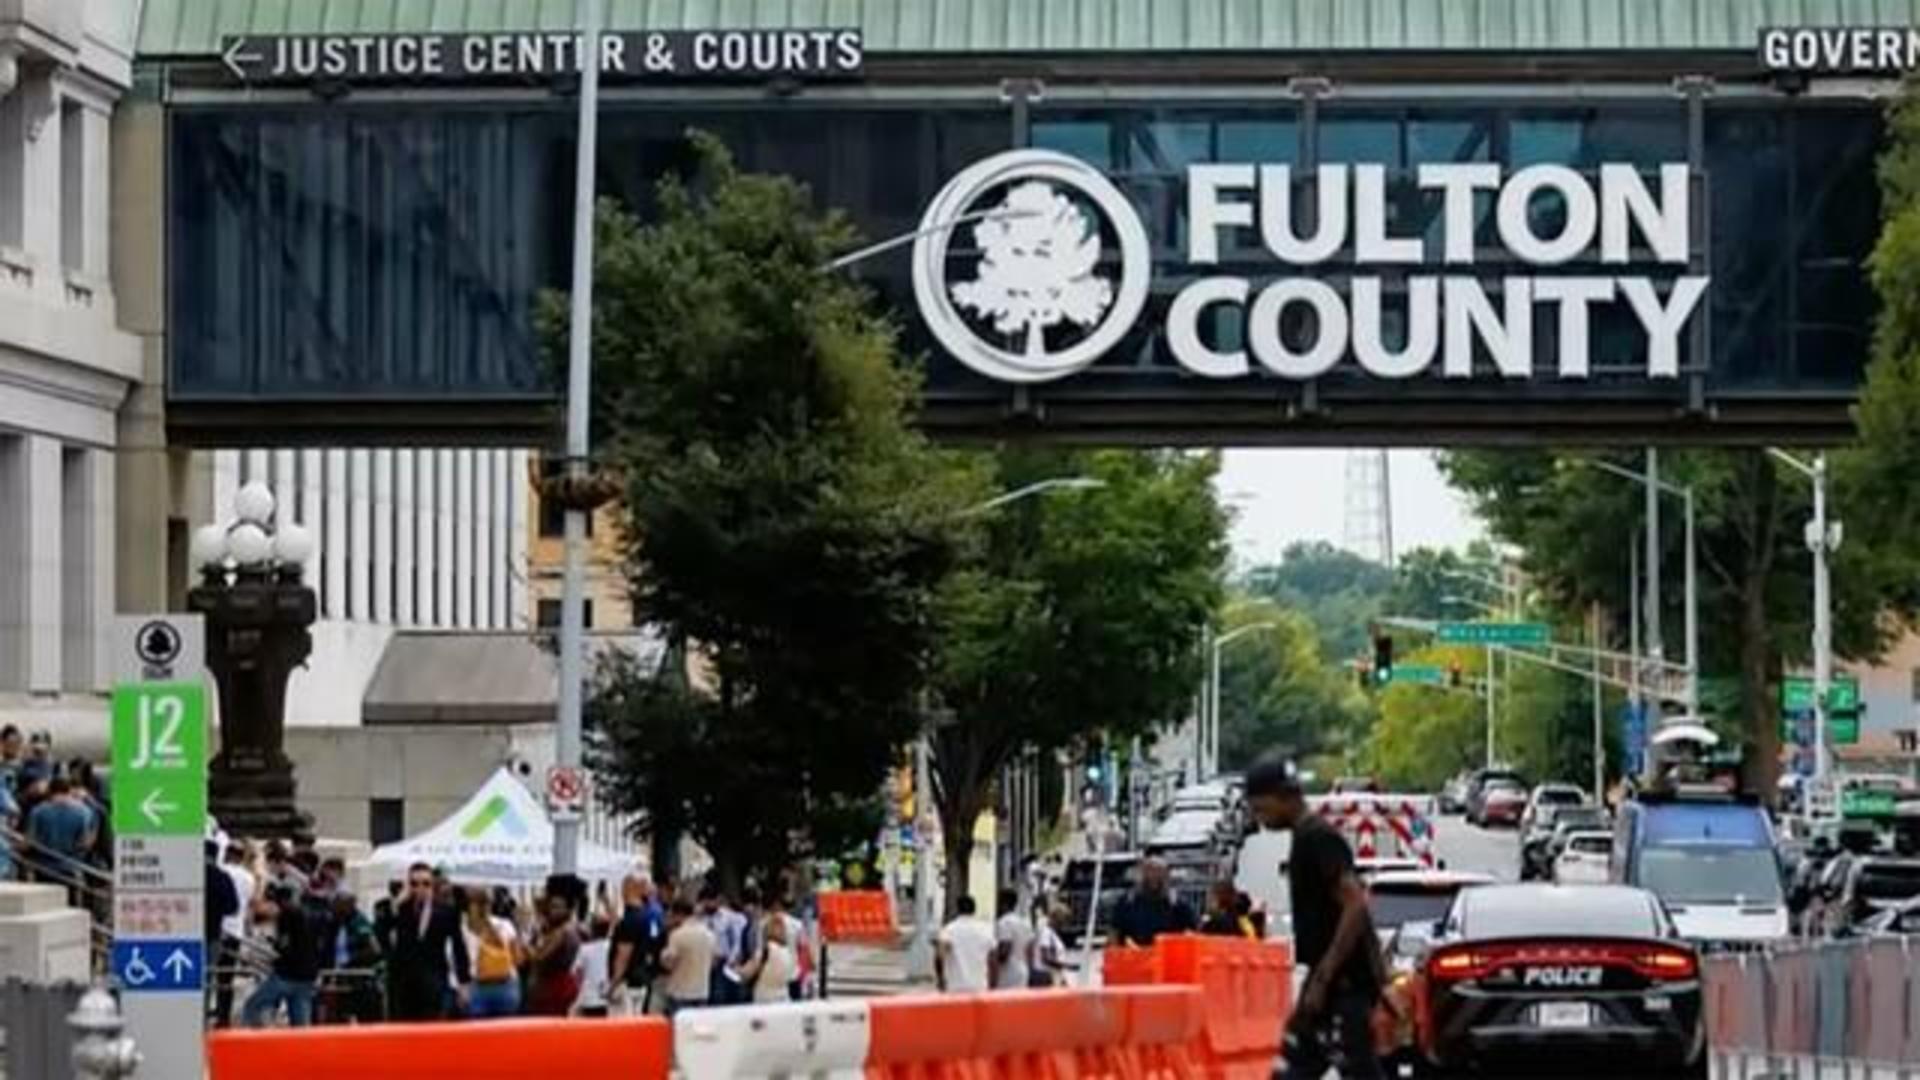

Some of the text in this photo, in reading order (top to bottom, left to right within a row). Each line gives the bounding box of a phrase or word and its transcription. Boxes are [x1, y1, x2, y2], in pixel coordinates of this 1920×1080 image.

[272, 36, 443, 75] JUSTICE
[644, 33, 675, 71] &
[694, 32, 862, 70] COURTS
[1187, 162, 1690, 265] FULTON
[1166, 275, 1710, 379] COUNTY
[129, 694, 184, 769] J2
[1523, 966, 1604, 986] POLICE
